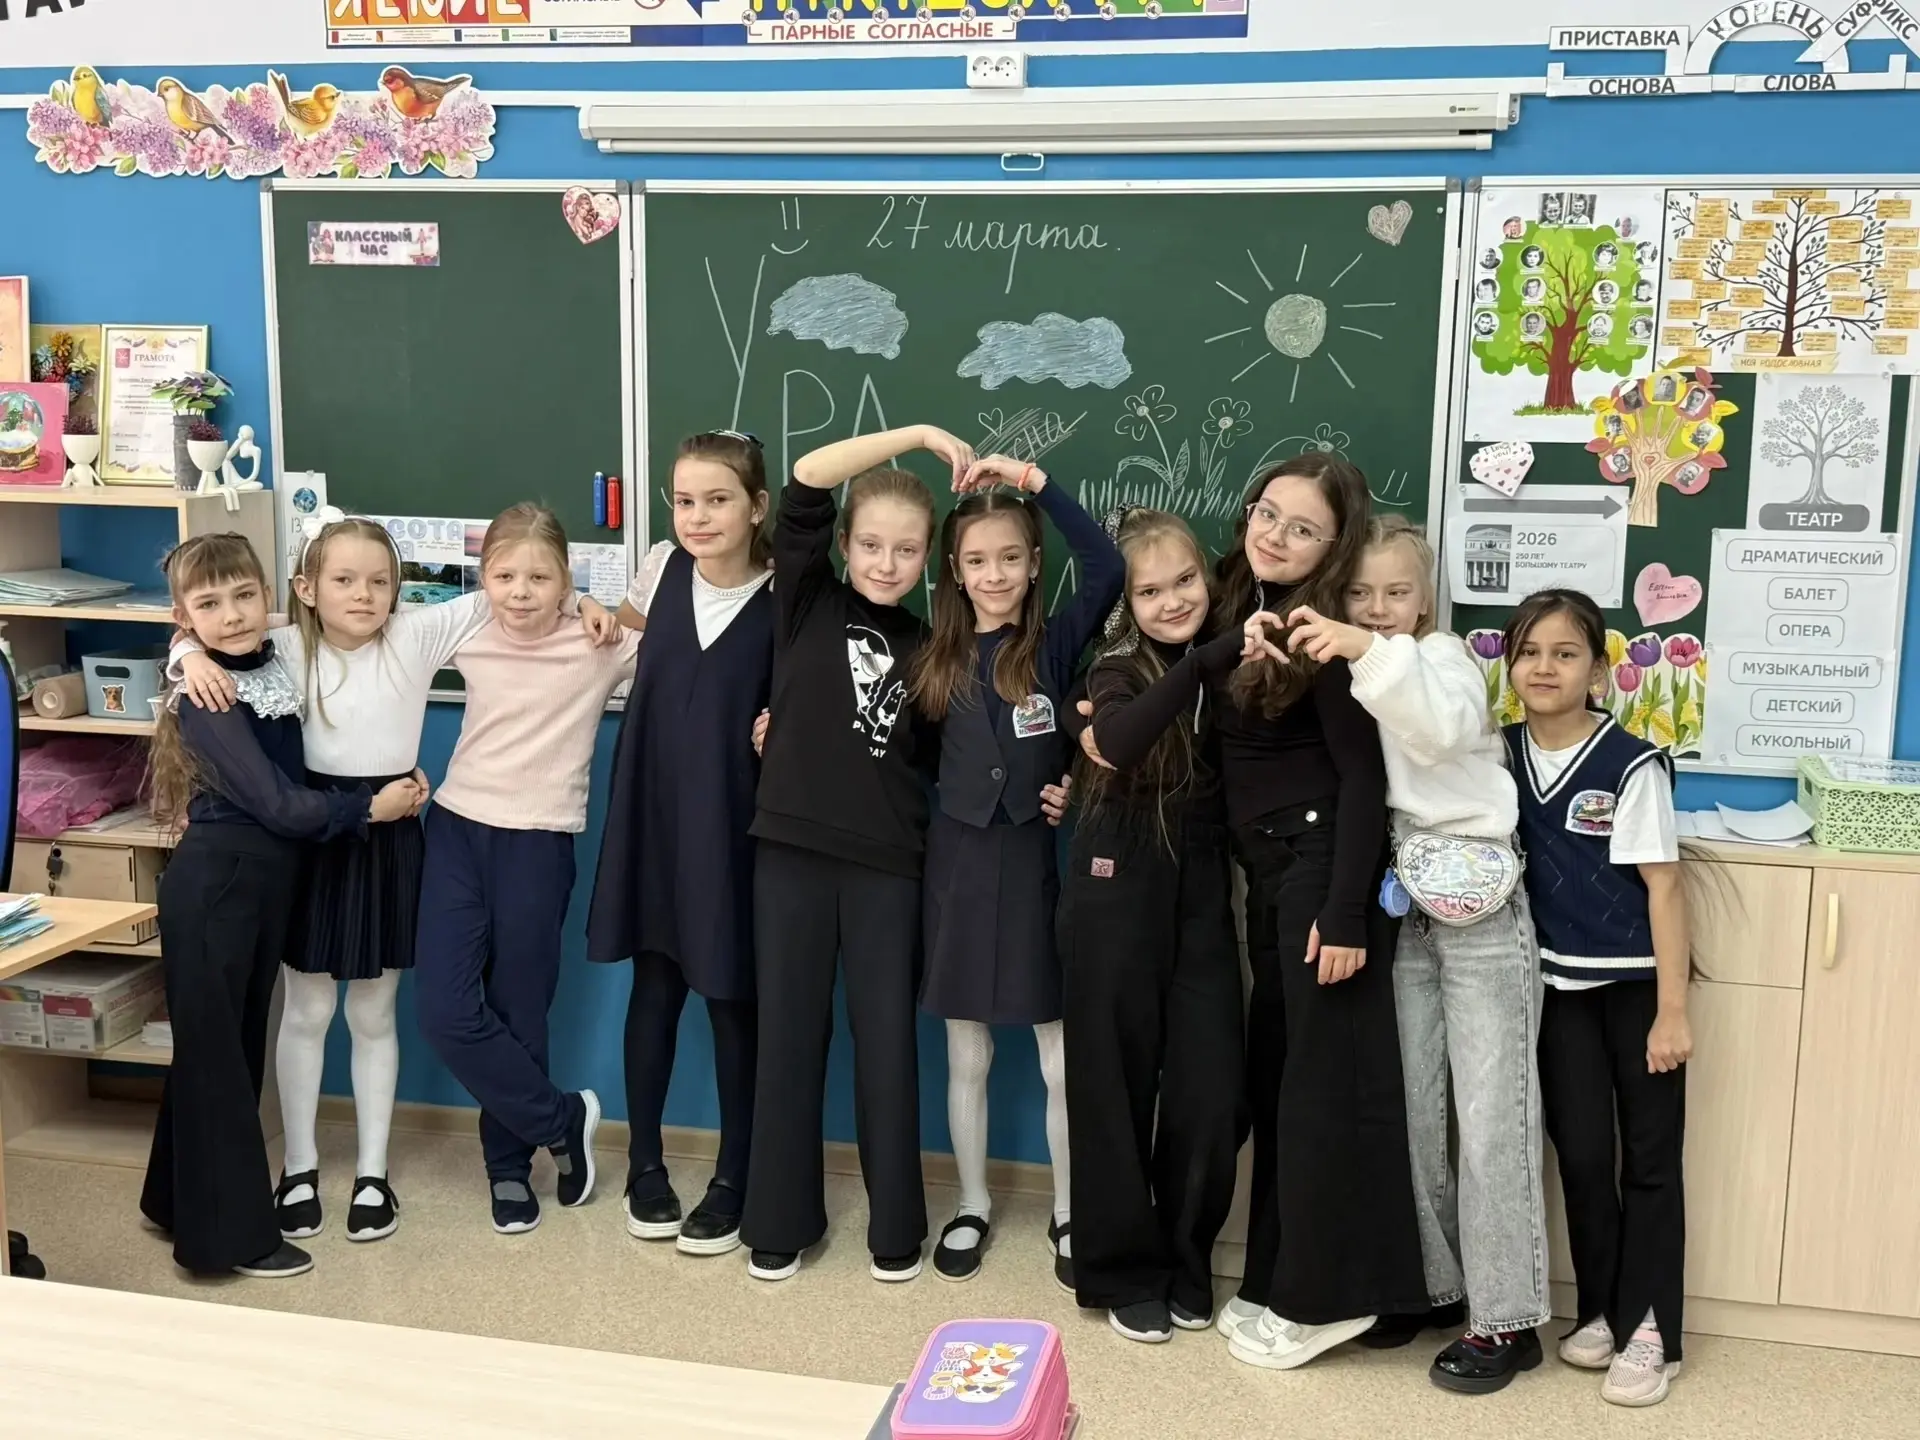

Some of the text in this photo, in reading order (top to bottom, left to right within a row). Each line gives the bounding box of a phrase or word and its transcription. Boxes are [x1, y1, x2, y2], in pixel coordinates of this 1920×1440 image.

[1706, 1, 1824, 41] КОРЕНЬ
[771, 22, 994, 41] ПАРНЫЕ СОГЛАСНЫЕ
[1559, 30, 1681, 46] ПРИСТАВКА
[1588, 74, 1837, 95] ОСНОВА СЛОВА
[866, 195, 931, 250] 27
[334, 227, 413, 243] КЛАССНЫЙ
[360, 244, 388, 256] ЧАС
[134, 353, 176, 363] ГРАМОТА
[1740, 359, 1757, 367] МОЯ
[1785, 511, 1844, 528] ТЕАТР
[1516, 532, 1558, 546] 2026
[1515, 561, 1558, 569] БОЛЬШОМУ
[1741, 549, 1884, 566] ДРАМАТИЧЕСКИЙ
[1783, 587, 1837, 601] БАЛЕТ
[1778, 624, 1832, 637] ОПЕРА
[1742, 661, 1870, 678] МУЗЫКАЛЬНЫЙ
[1766, 698, 1843, 714] ДЕТСКИЙ
[1751, 734, 1851, 750] КУКОЛЬНЫЙ
